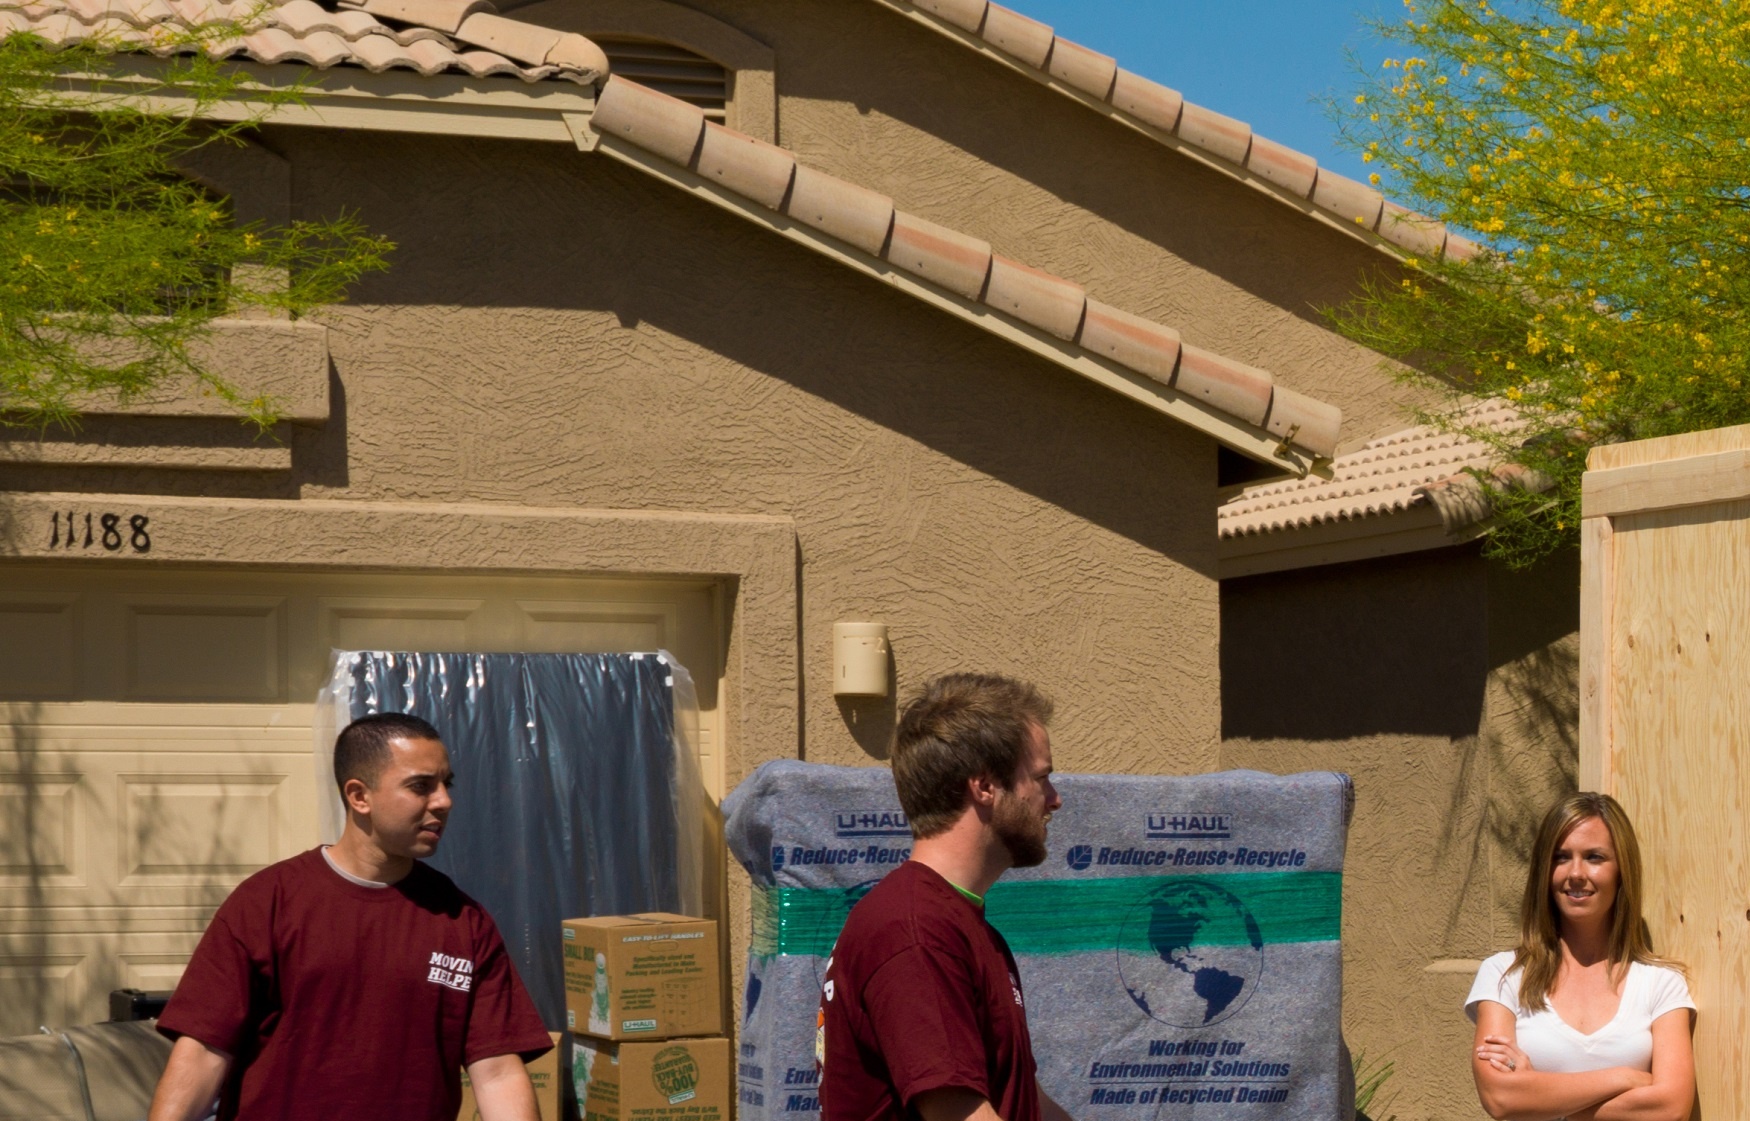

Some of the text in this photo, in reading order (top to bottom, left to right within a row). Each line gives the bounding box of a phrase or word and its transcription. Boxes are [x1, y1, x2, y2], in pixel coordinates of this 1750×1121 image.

[49, 510, 151, 553] 11188
[1148, 816, 1229, 831] U-HAUL
[1149, 1039, 1246, 1057] Working for
[1090, 1060, 1290, 1079] Environmental Solutions
[1090, 1086, 1289, 1105] Made of Recycled Denim
